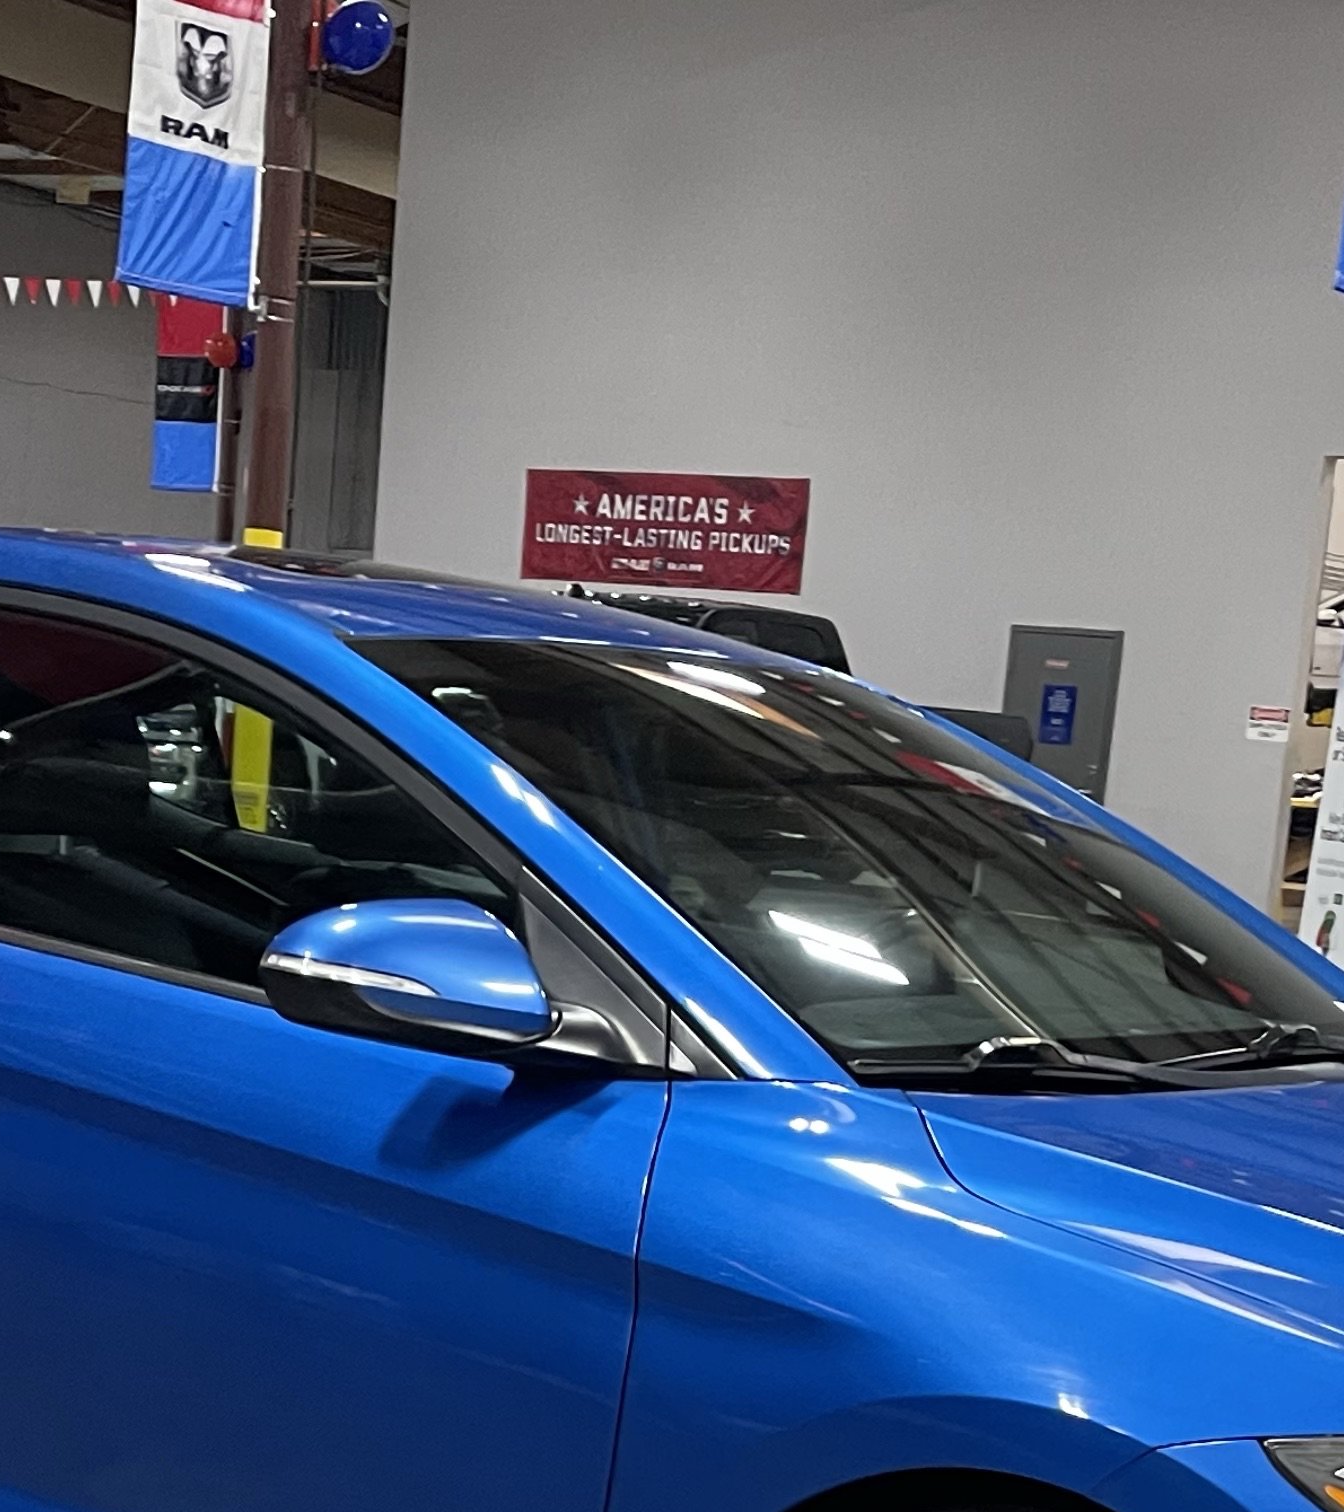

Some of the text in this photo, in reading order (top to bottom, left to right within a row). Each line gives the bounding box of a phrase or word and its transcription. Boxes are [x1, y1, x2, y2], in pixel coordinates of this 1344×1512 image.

[160, 114, 230, 150] RAM
[596, 492, 730, 525] AMERICA'S
[535, 521, 791, 556] LONGEST-LASTING PICKUPS
